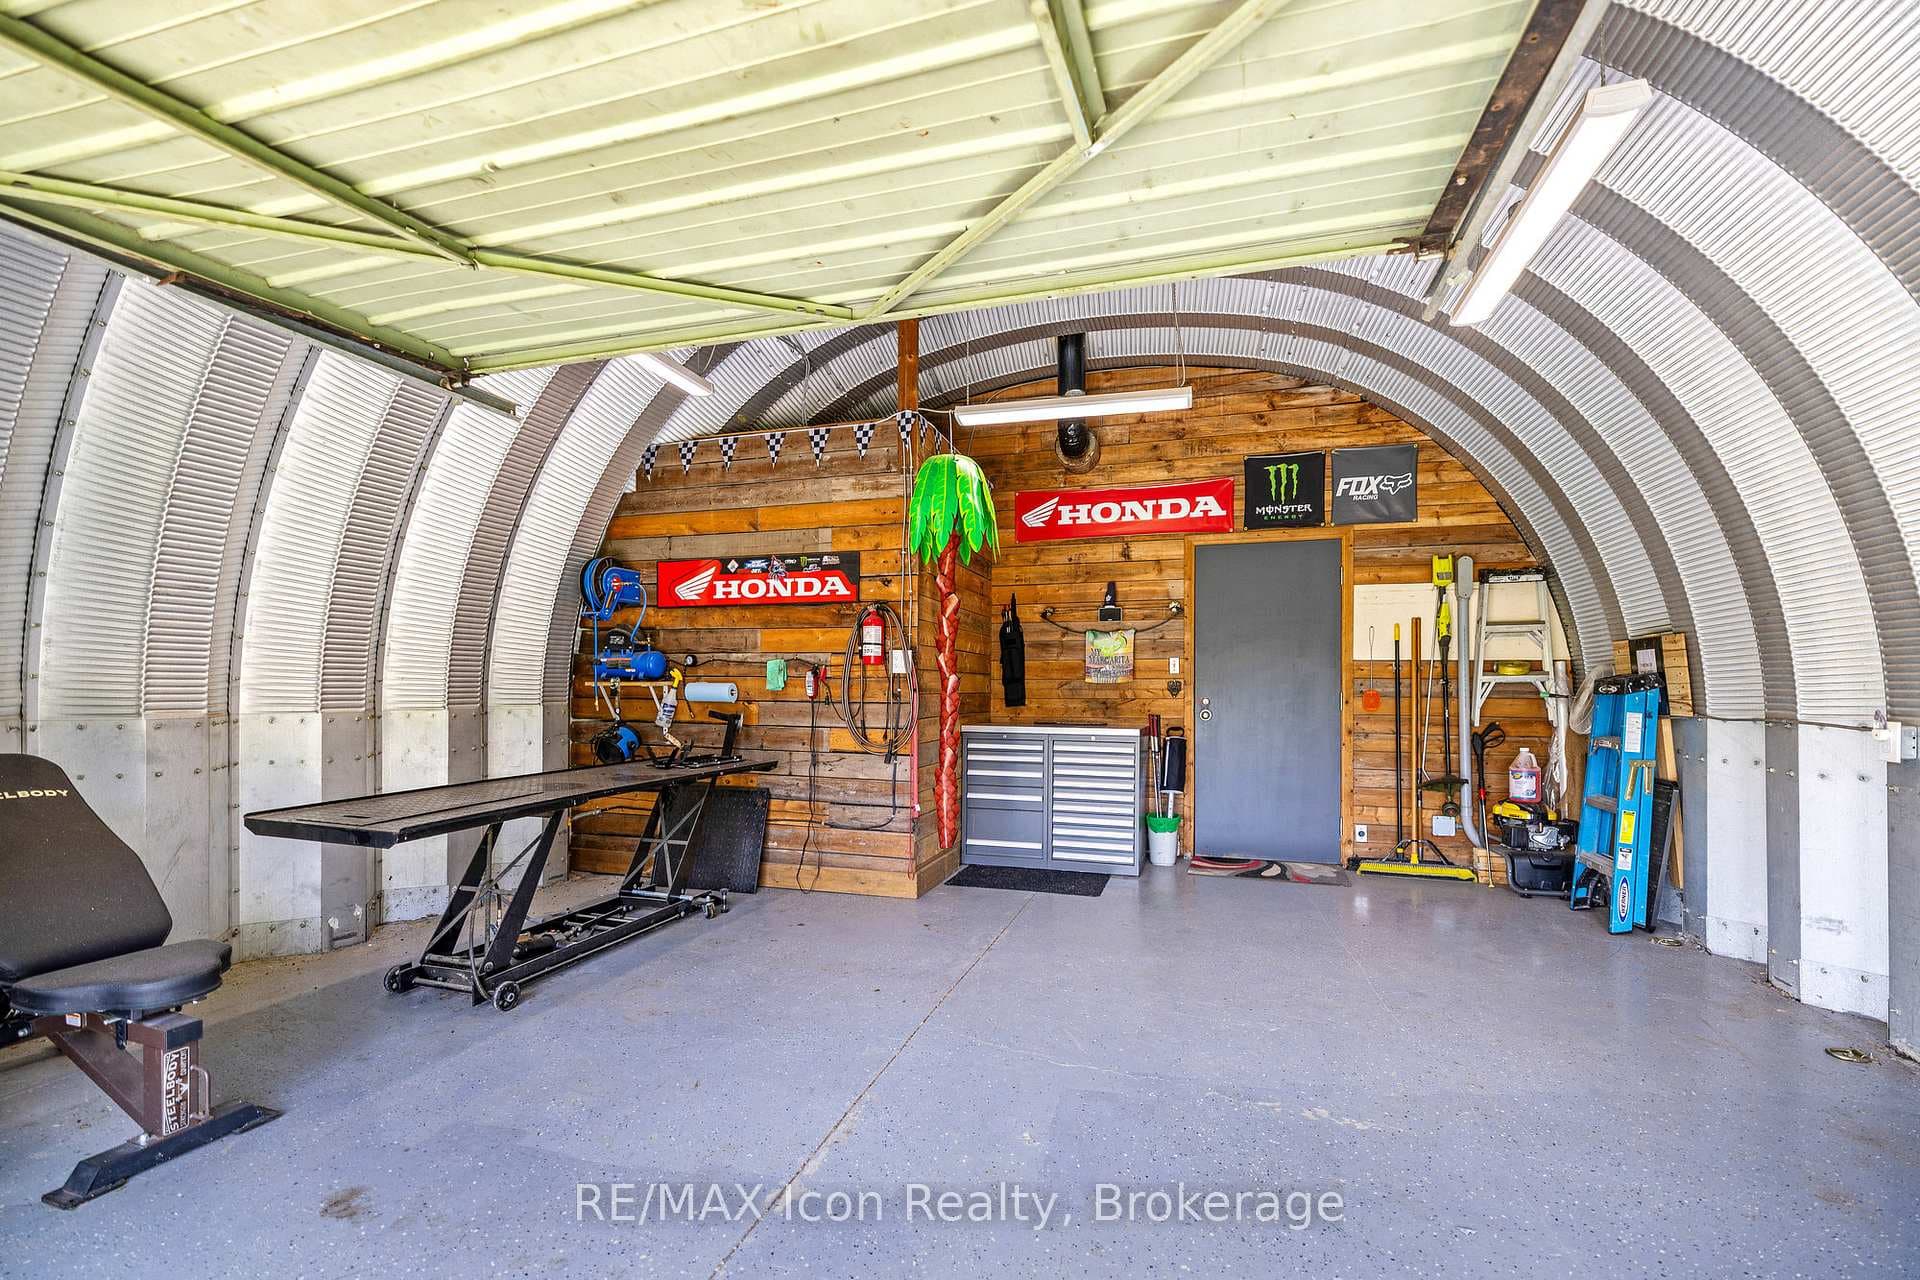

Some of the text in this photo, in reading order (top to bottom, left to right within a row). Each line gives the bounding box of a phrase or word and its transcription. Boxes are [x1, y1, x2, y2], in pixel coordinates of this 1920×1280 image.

[1336, 475, 1384, 497] FOX
[1057, 495, 1227, 526] HONDA
[1255, 503, 1313, 515] MONSTER
[713, 576, 851, 599] HONDA
[1088, 655, 1130, 665] MARGARITA
[166, 1052, 180, 1131] STEELBODY
